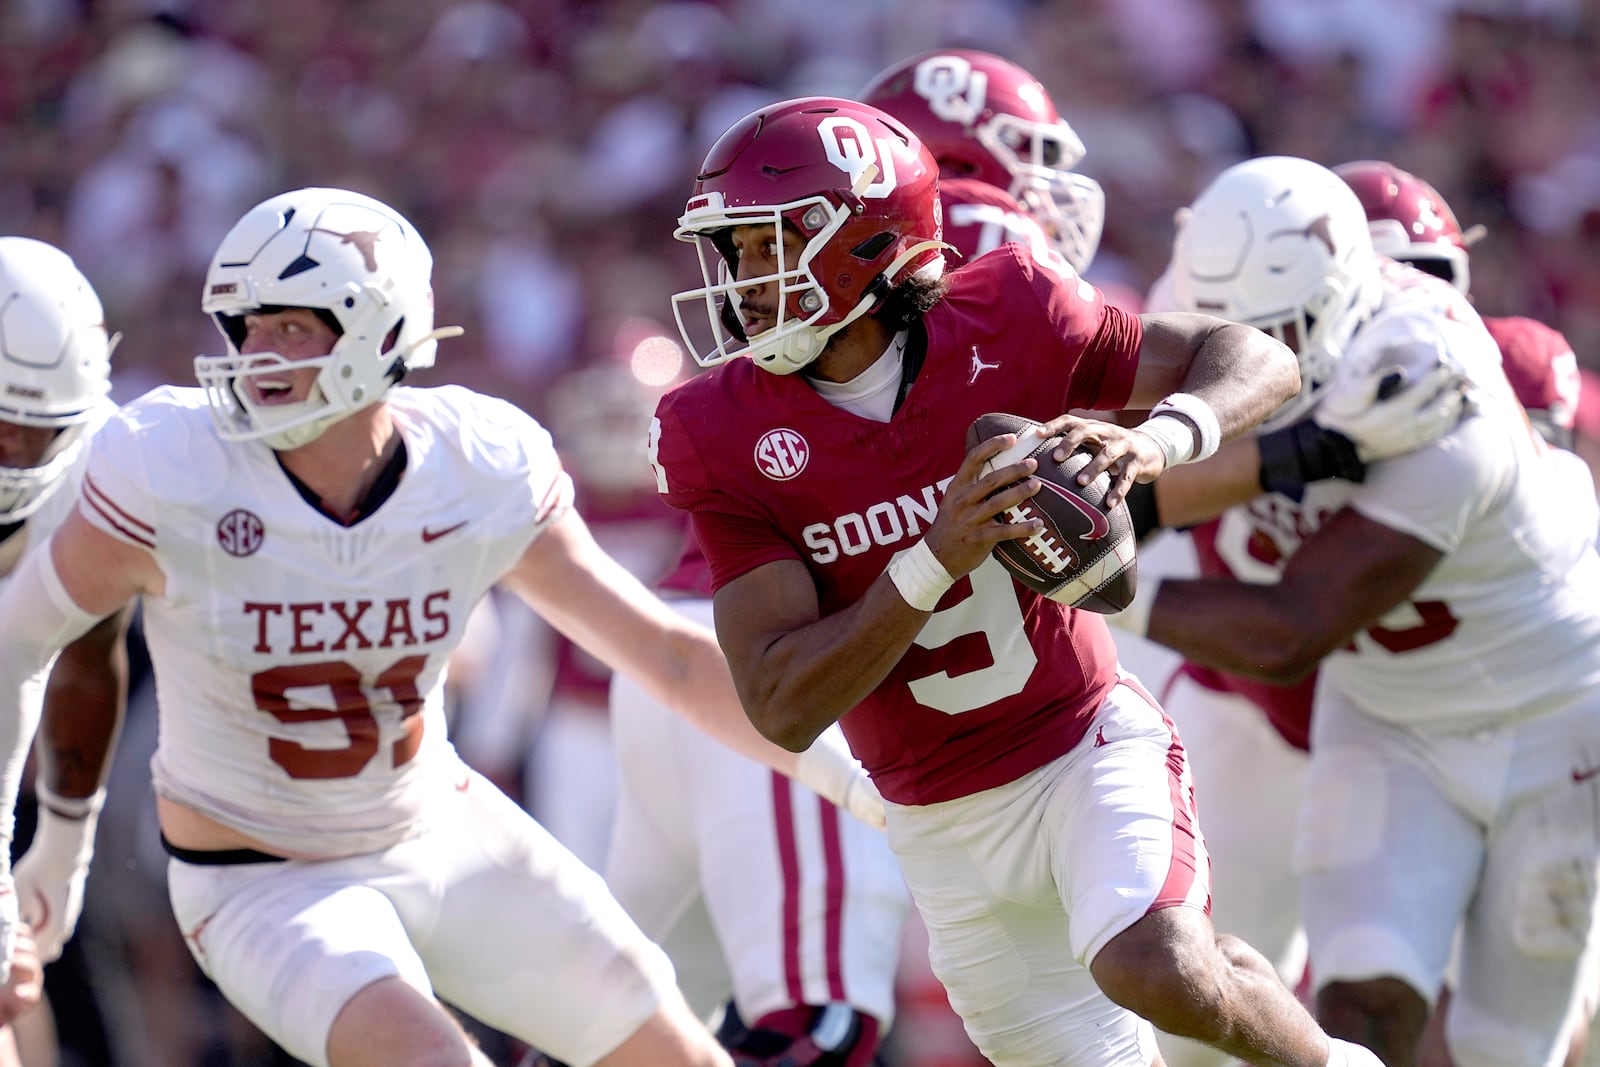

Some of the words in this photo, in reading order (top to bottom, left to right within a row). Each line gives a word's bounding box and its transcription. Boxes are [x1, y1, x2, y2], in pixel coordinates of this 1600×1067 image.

[914, 56, 988, 124] OU
[817, 116, 897, 199] OU
[757, 431, 806, 477] SEC
[219, 511, 263, 555] SEC
[802, 475, 956, 564] SOON
[243, 591, 450, 653] TEXAS
[881, 549, 1038, 715] 9
[252, 654, 430, 779] 91
